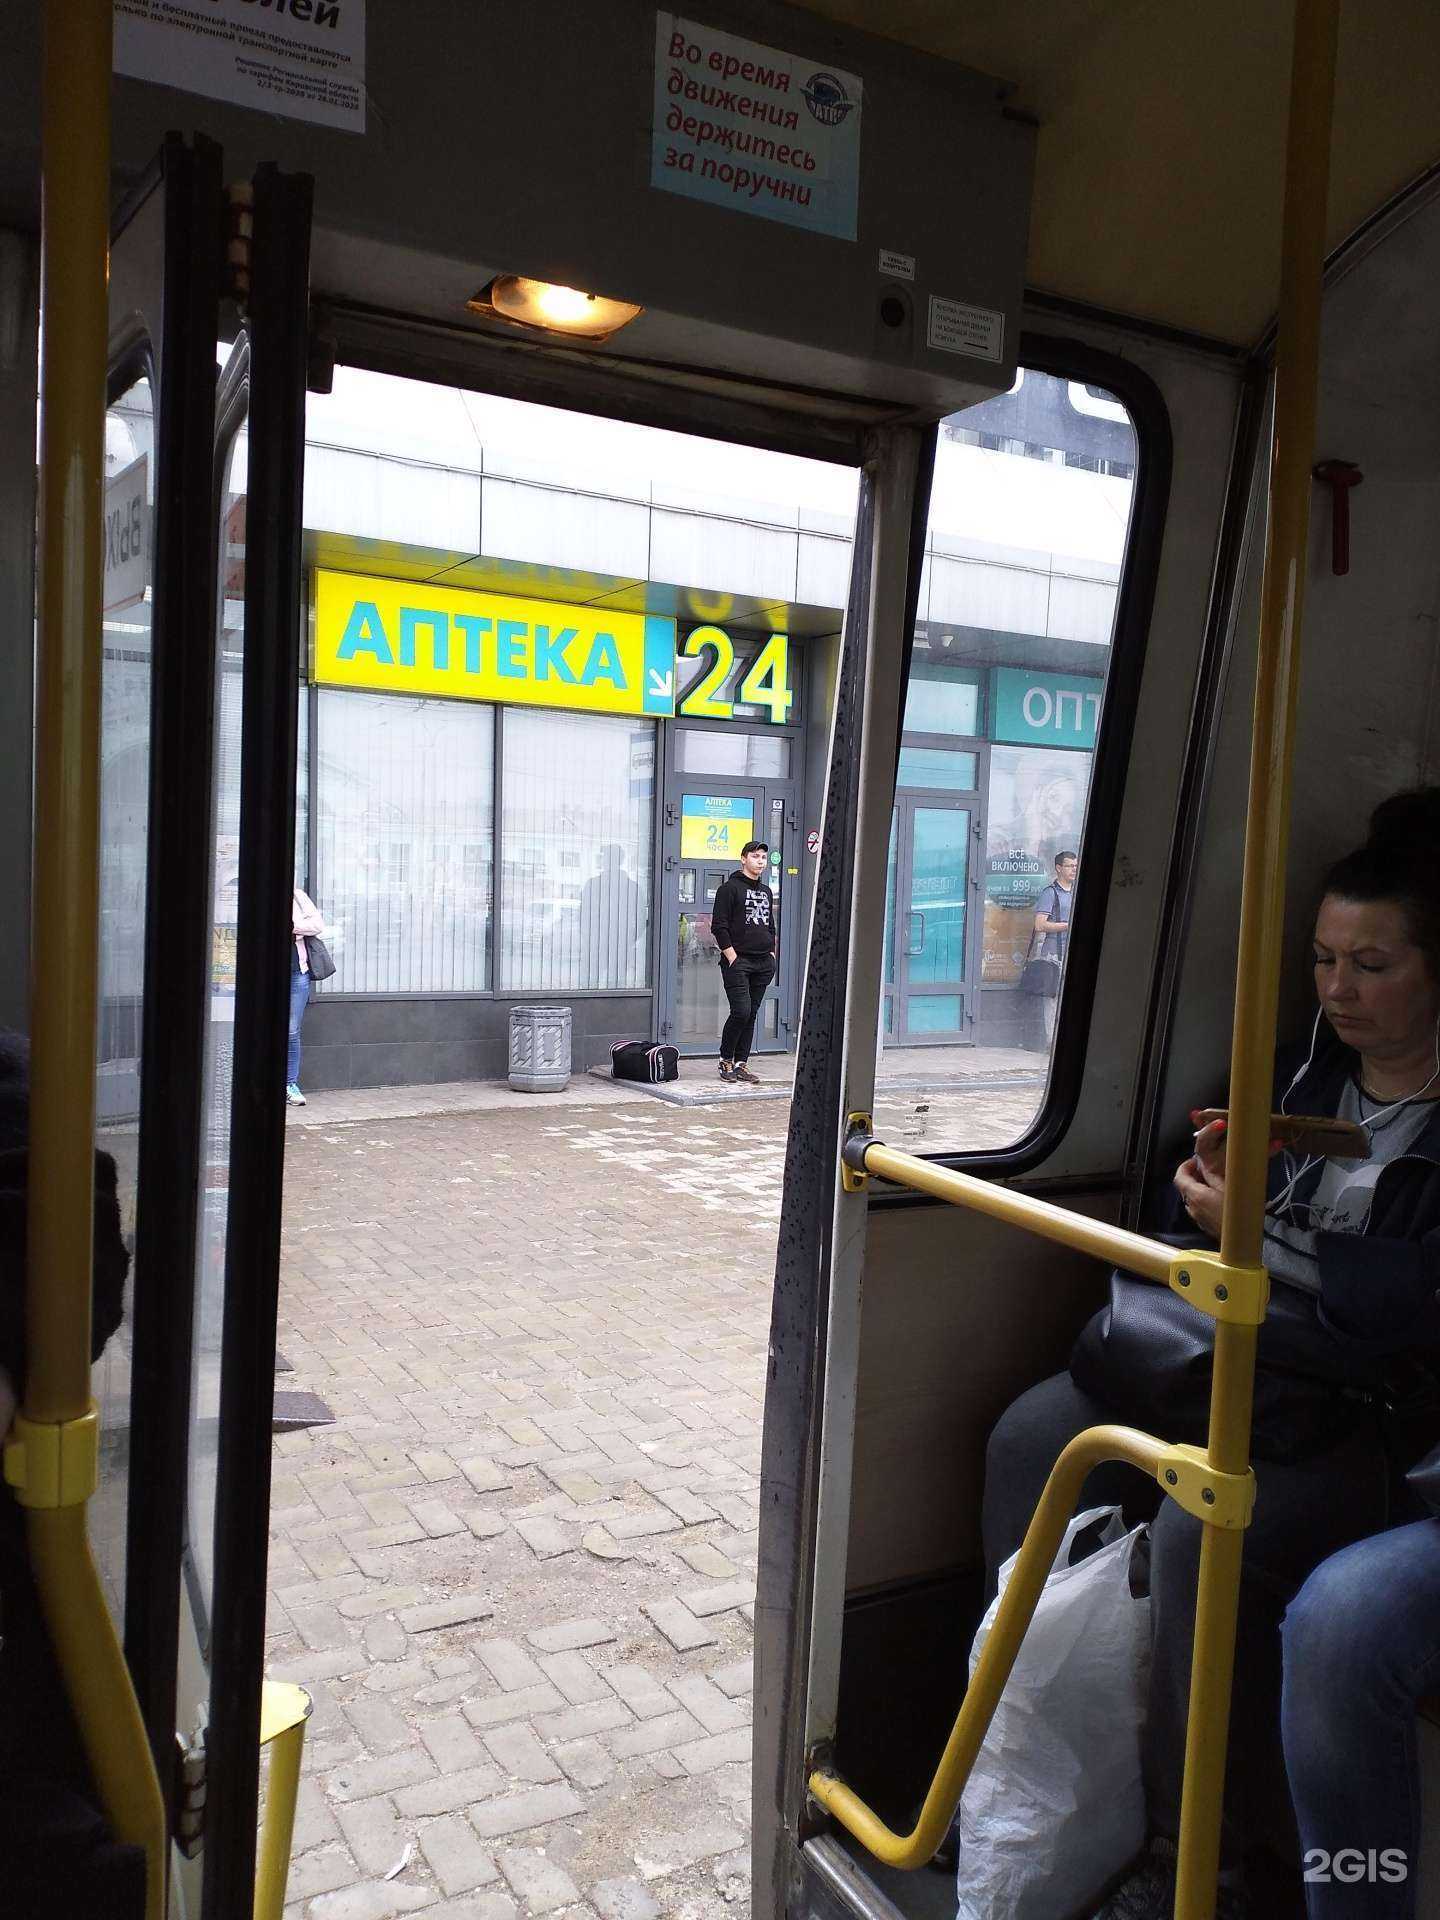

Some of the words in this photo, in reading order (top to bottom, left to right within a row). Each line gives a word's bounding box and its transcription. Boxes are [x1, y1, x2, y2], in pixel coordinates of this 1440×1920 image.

[114, 4, 148, 18] олько
[150, 12, 165, 22] по
[167, 16, 236, 42] электронной
[162, 3, 227, 28] бесплатный
[668, 31, 702, 65] Во
[708, 50, 791, 93] время
[667, 67, 800, 131] движения
[665, 102, 816, 172] держитесь
[663, 146, 695, 174] за
[701, 156, 813, 206] поручни
[335, 600, 629, 690] АПТЕКА
[678, 623, 793, 725] 24
[1022, 686, 1103, 733] ОПТ
[704, 796, 733, 807] АПТЕКА
[706, 824, 729, 844] 24
[991, 861, 1040, 872] ВКЛЮЧЕНО
[1012, 879, 1031, 892] 999
